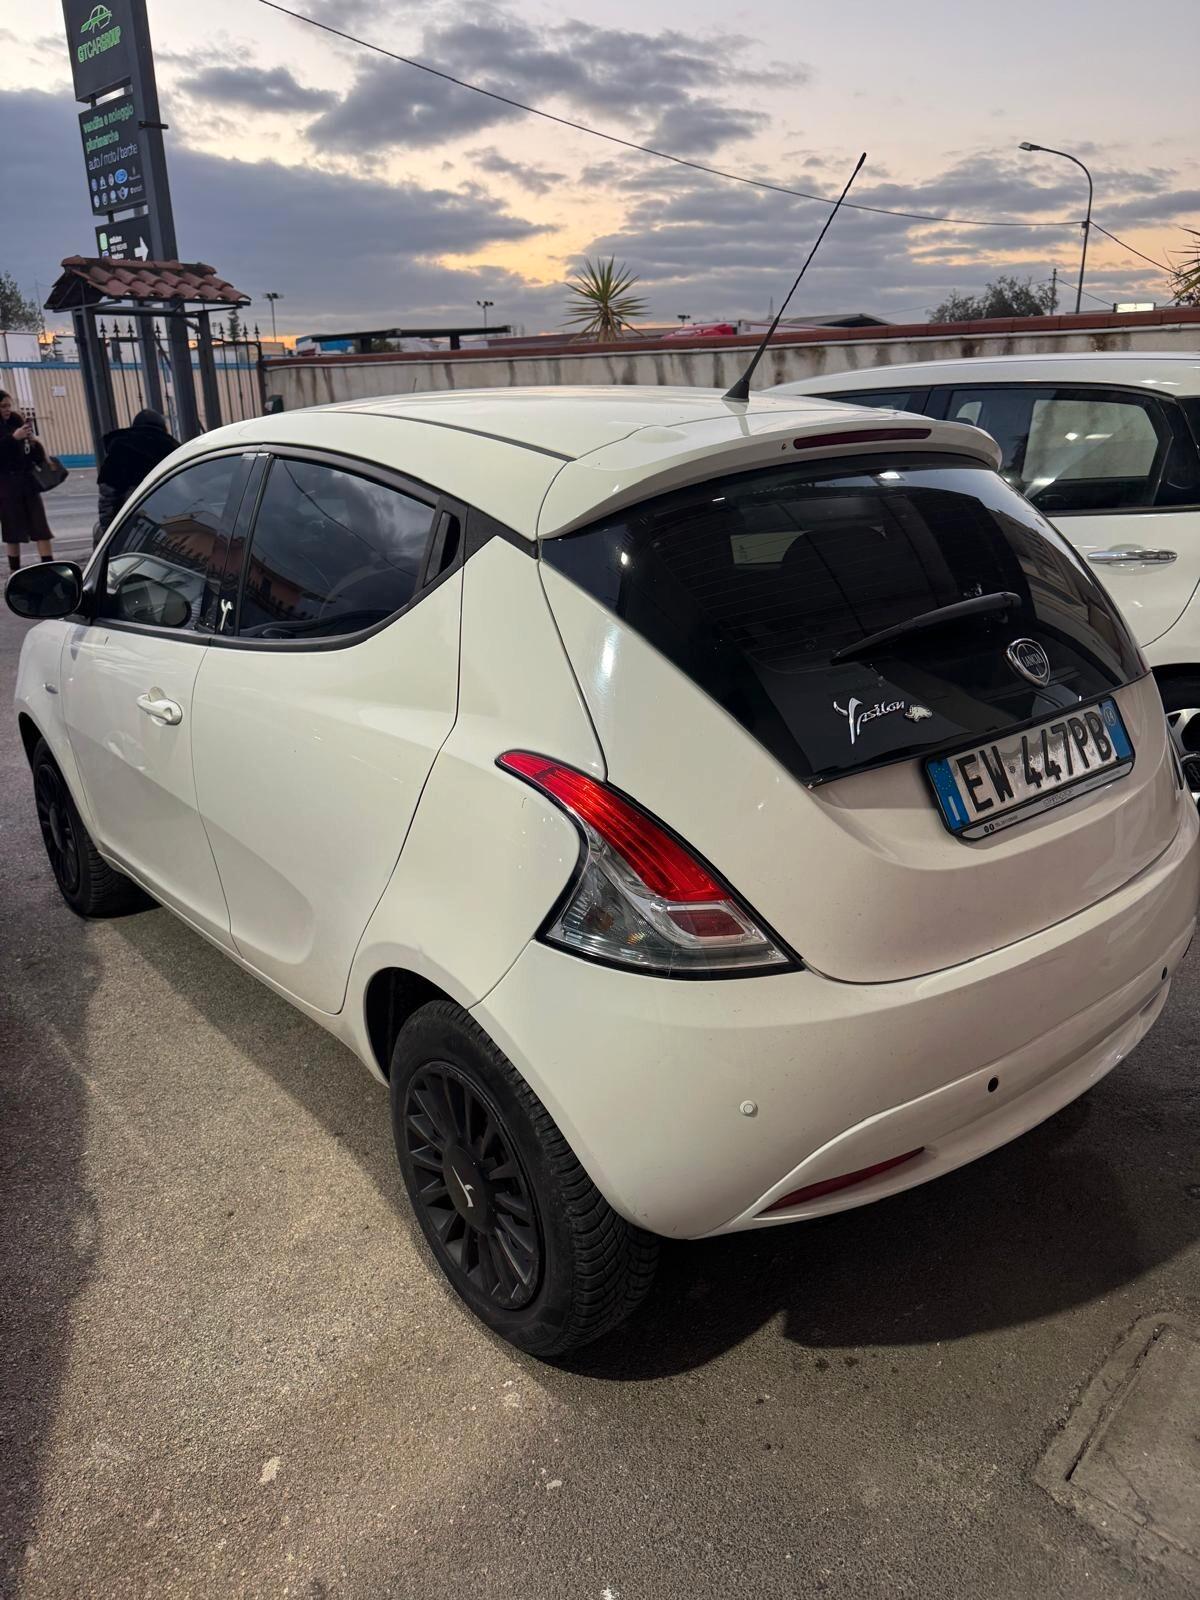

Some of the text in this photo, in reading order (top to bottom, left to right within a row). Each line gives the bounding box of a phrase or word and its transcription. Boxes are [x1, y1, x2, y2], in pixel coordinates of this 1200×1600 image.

[83, 115, 104, 133] vendita
[108, 103, 134, 121] noleggio
[88, 156, 101, 170] auto
[120, 143, 138, 158] barche
[833, 697, 905, 744] Ypsilon
[955, 745, 1015, 813] EW
[1021, 711, 1113, 789] 447PB
